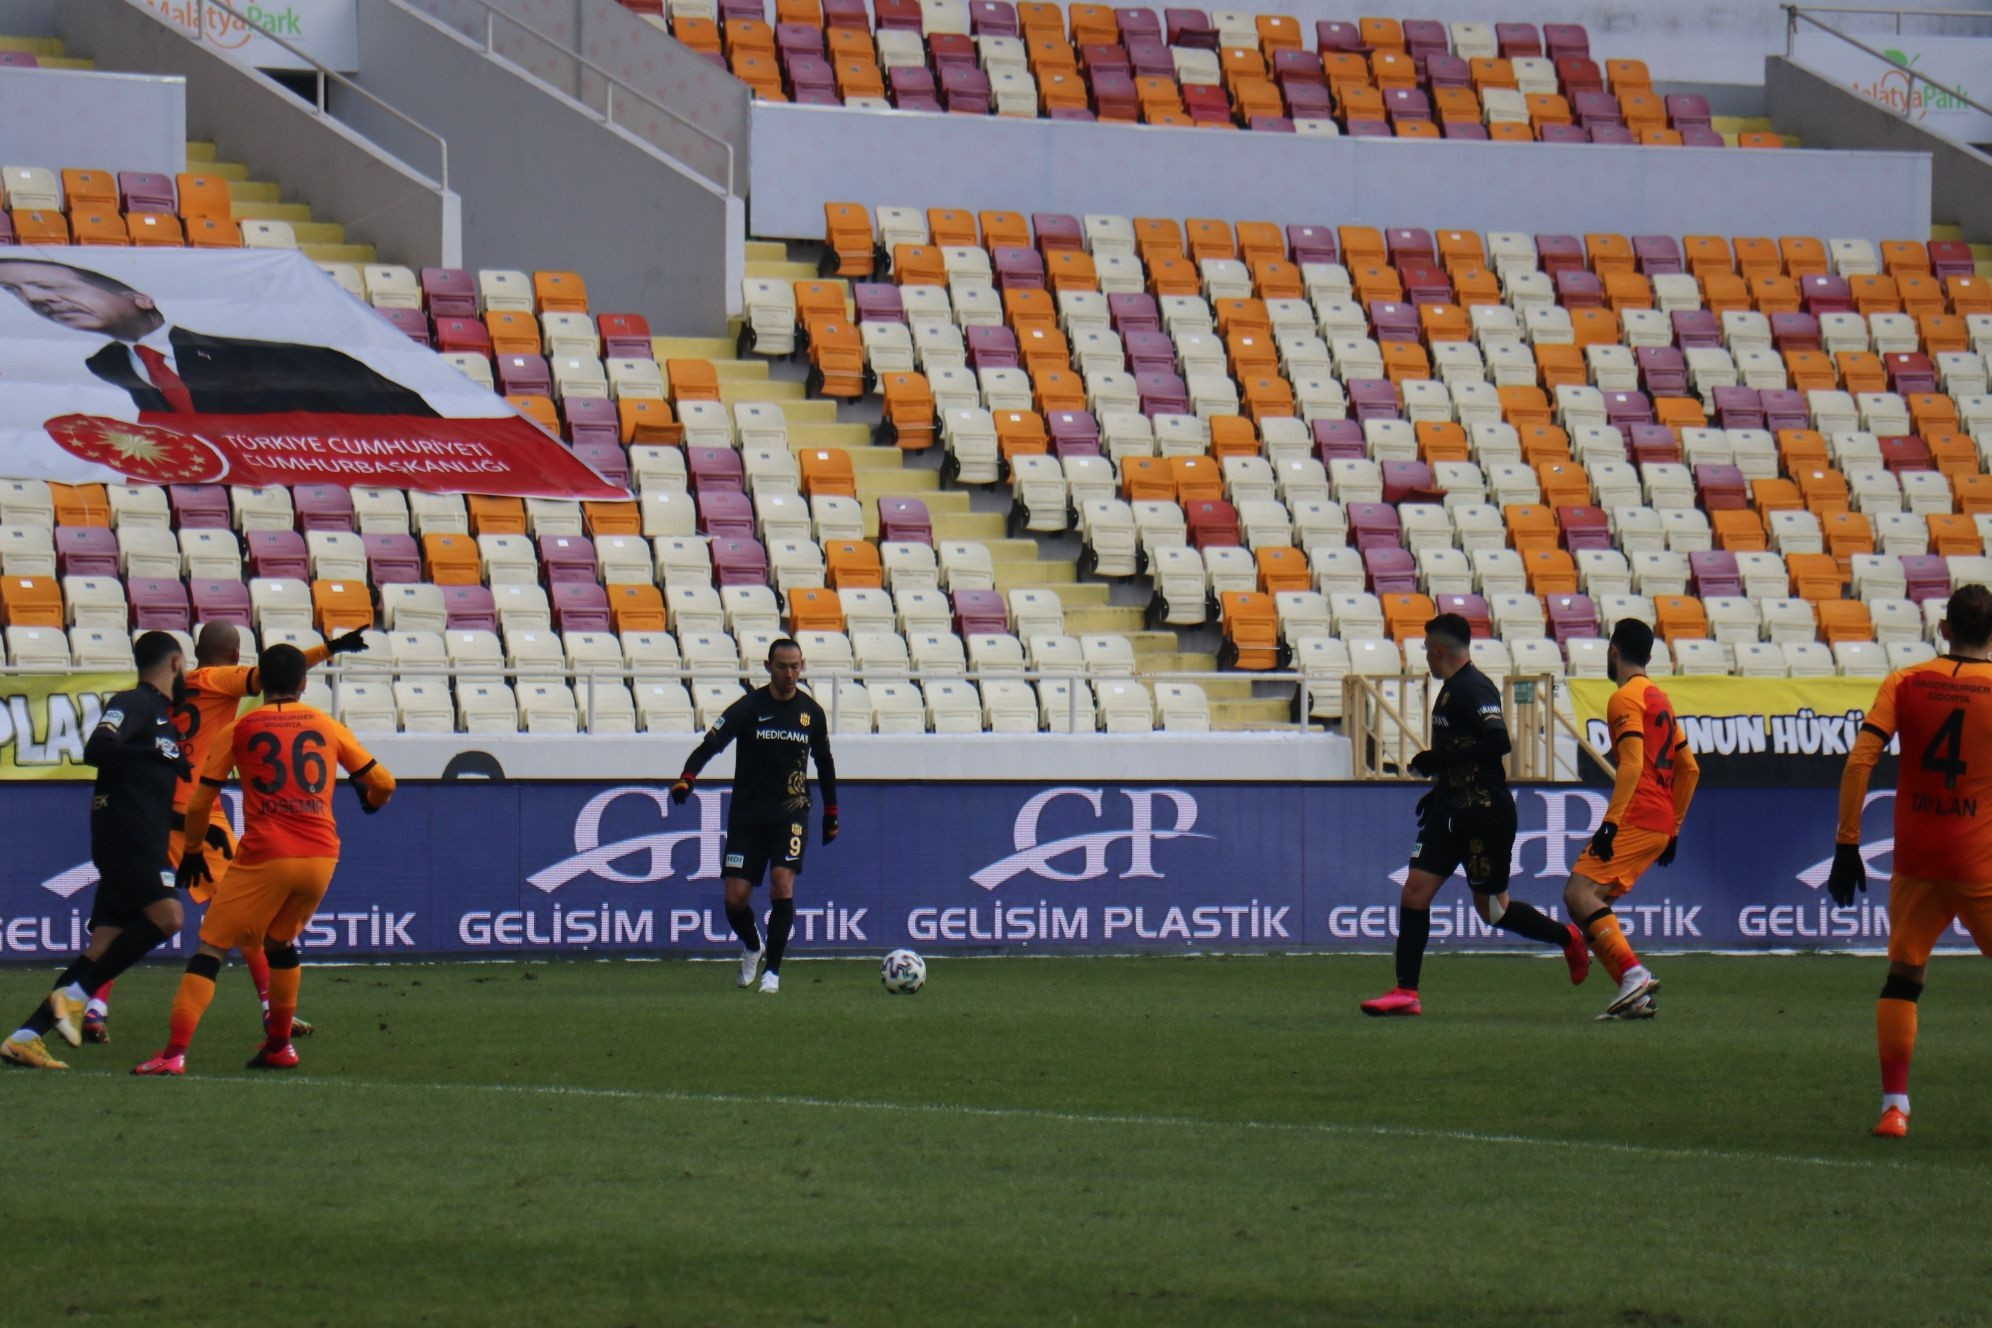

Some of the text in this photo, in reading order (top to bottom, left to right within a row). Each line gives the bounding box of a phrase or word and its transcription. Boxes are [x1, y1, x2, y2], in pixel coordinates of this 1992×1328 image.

[248, 730, 327, 795] 36
[1922, 708, 1967, 790] 4
[1911, 791, 1977, 818] TAYLAN
[789, 836, 801, 857] 9
[1009, 787, 1200, 883] GP
[1104, 898, 1290, 939] PLASTİK
